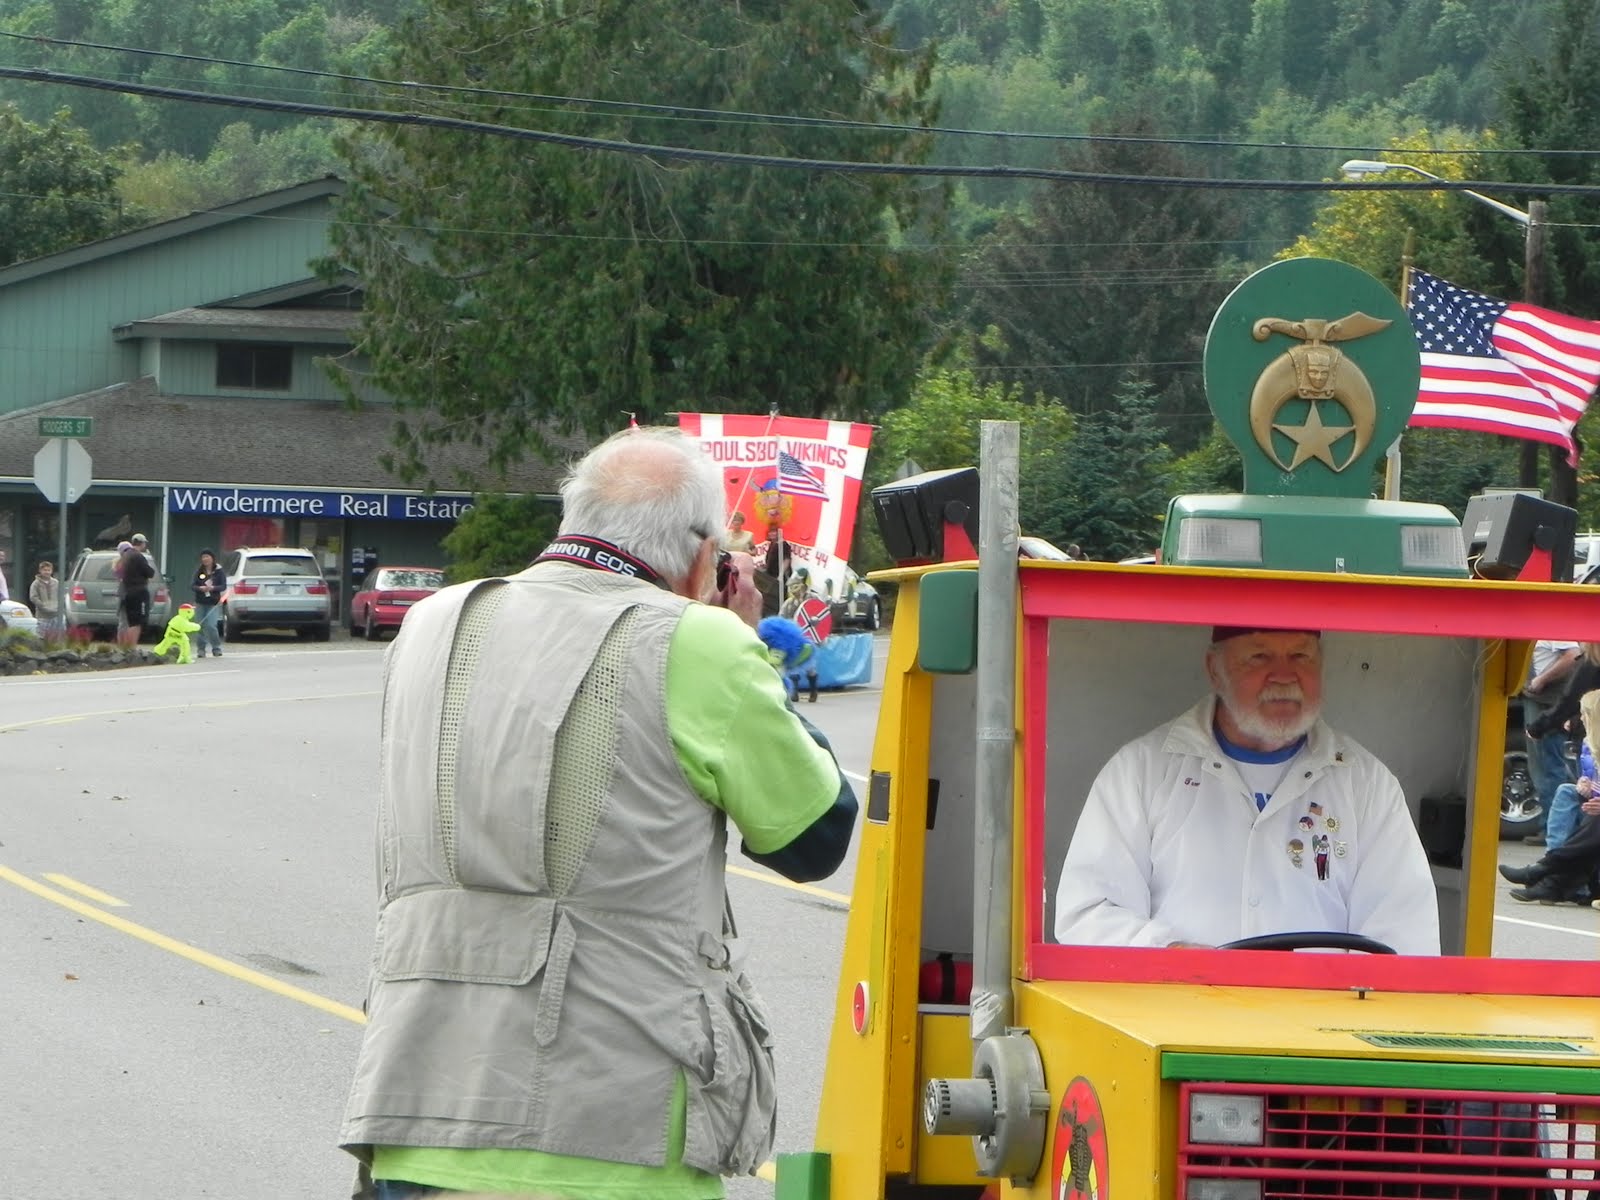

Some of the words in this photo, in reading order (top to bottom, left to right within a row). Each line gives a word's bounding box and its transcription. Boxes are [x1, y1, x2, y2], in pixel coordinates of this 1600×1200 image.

[77, 421, 86, 433] ST
[701, 441, 778, 462] POULSBO
[787, 441, 848, 469] VIKINGS
[174, 489, 324, 515] Windermere
[340, 494, 388, 517] Real
[546, 543, 590, 558] anon
[595, 551, 638, 577] EOS
[816, 551, 828, 568] 44
